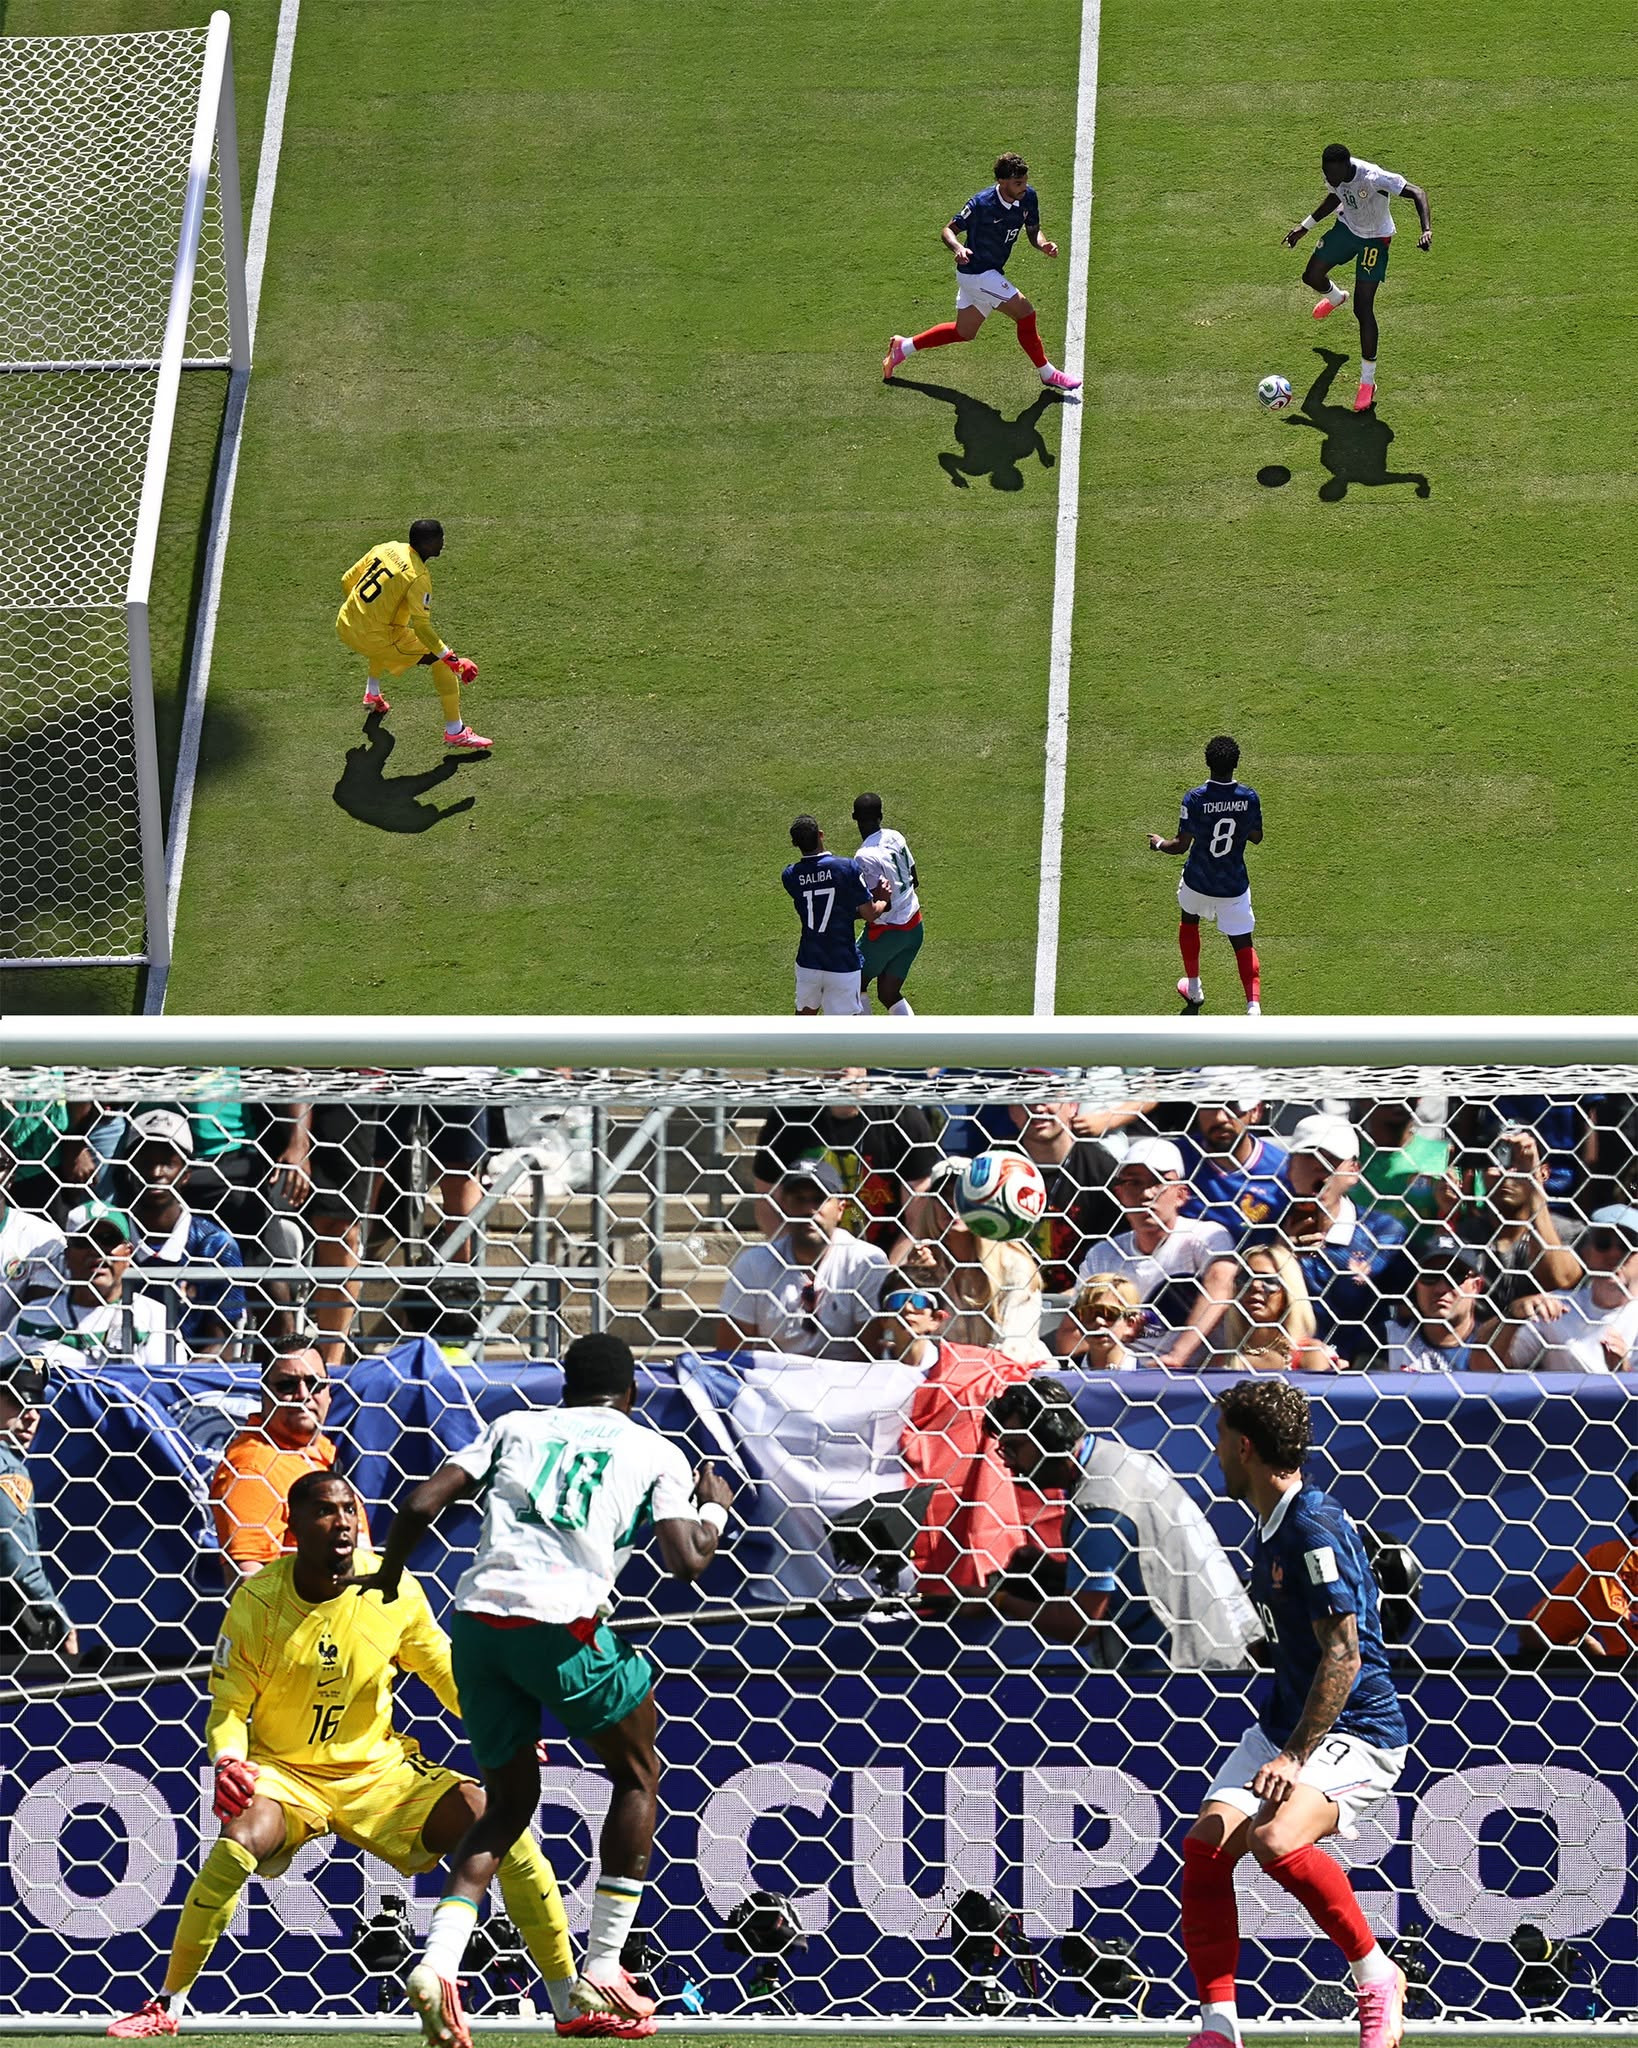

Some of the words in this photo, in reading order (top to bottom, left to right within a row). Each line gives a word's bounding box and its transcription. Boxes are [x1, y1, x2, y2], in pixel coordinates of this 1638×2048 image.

[1004, 228, 1019, 243] 19
[1360, 246, 1379, 267] 18
[354, 556, 395, 604] 16
[1209, 817, 1237, 858] 8
[798, 869, 833, 886] SALIBA
[802, 887, 836, 933] 17
[308, 1704, 346, 1745] 16
[697, 1762, 1162, 1940] CUP
